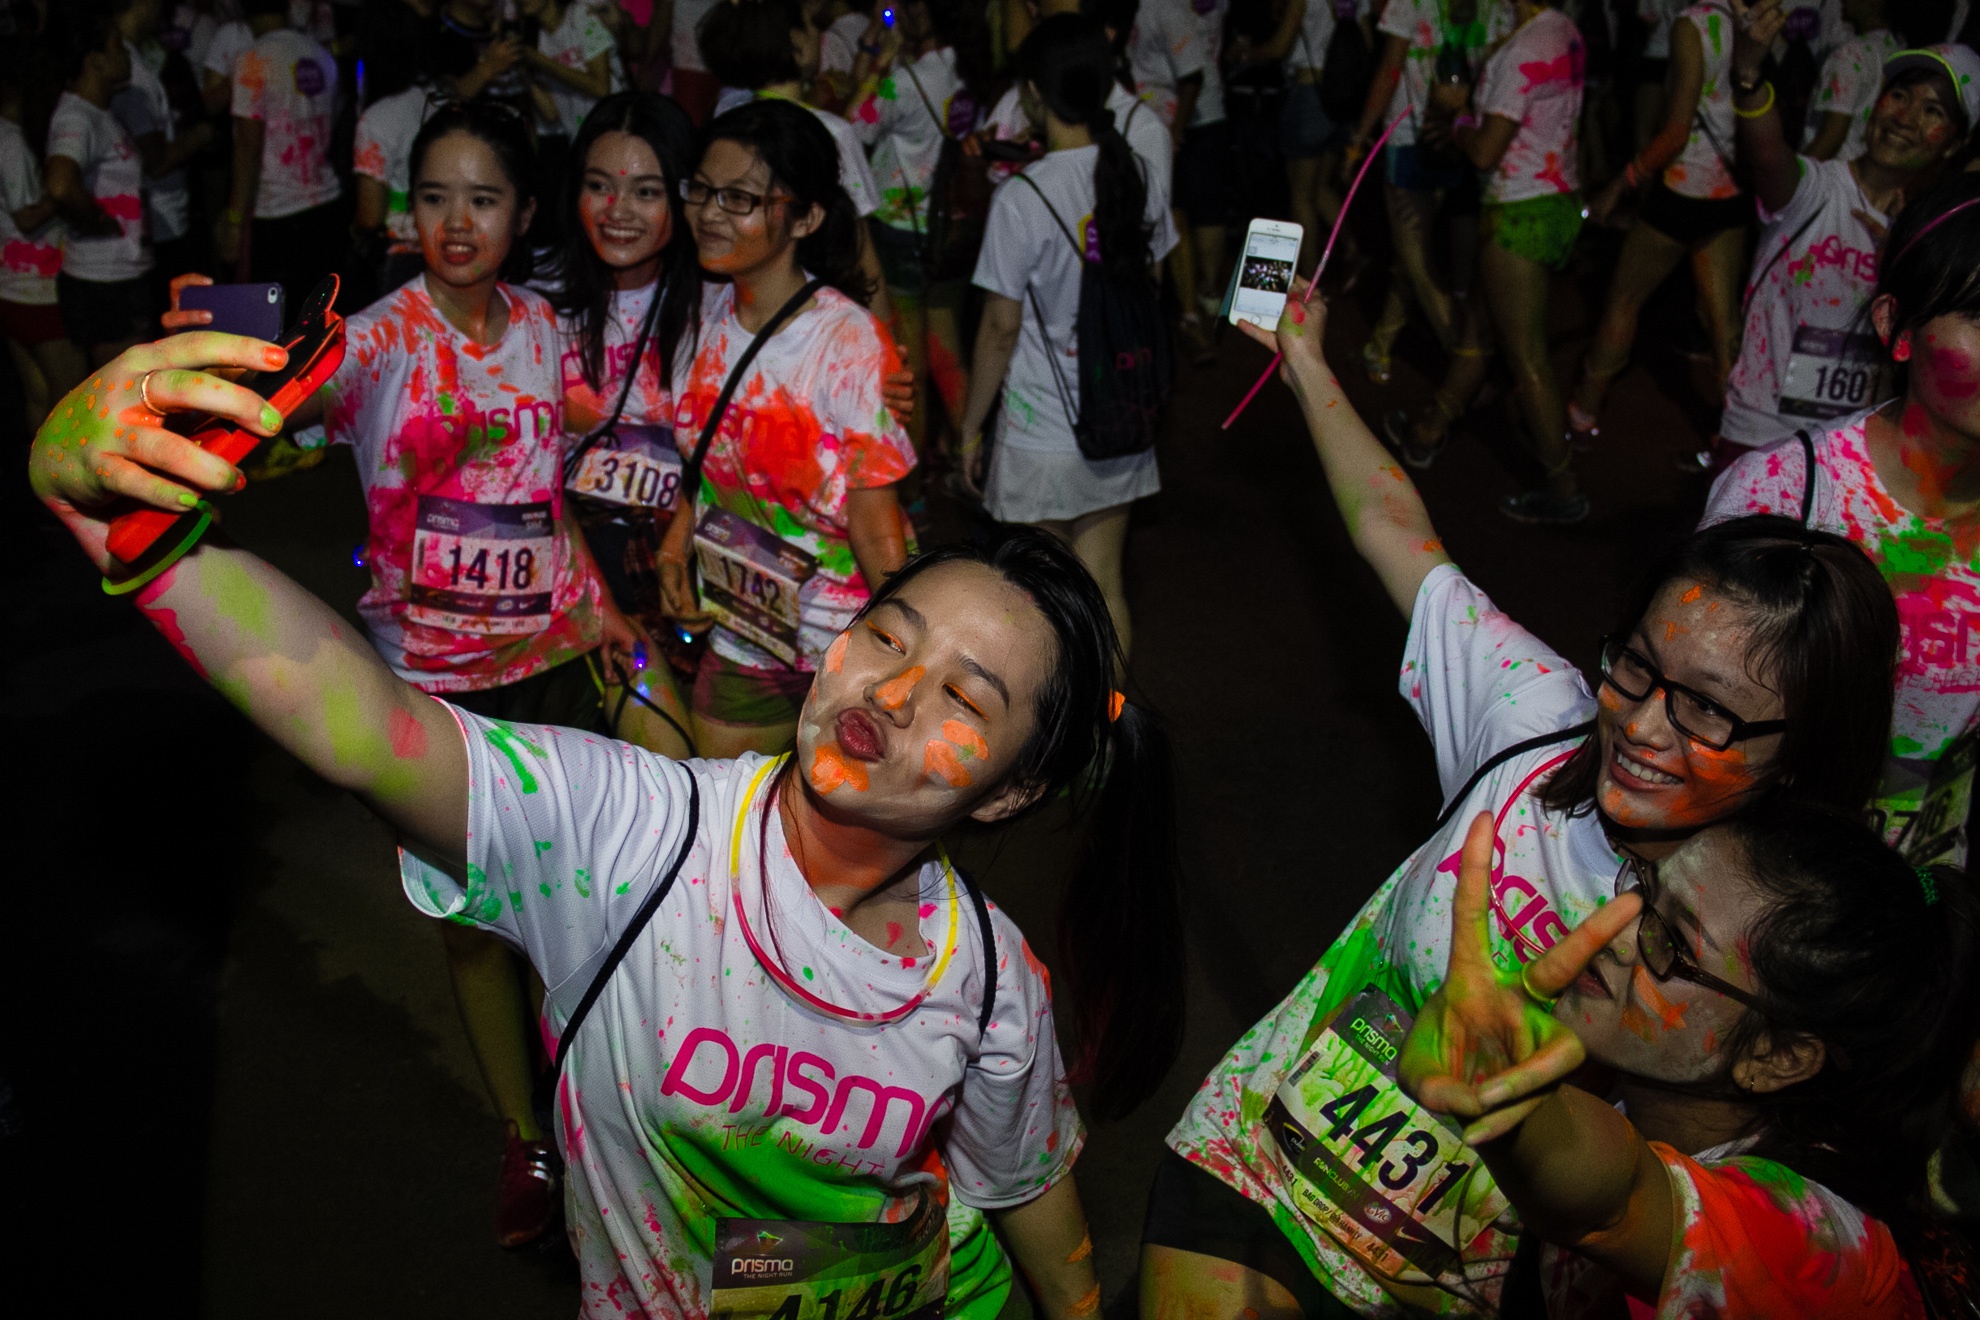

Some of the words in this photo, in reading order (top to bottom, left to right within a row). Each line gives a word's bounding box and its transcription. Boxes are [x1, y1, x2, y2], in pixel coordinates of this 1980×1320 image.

[1815, 365, 1868, 403] 160
[594, 457, 681, 508] 3108
[450, 545, 534, 590] 1418
[720, 557, 783, 615] 1742
[1350, 1018, 1398, 1061] prisma
[722, 1124, 769, 1150] THE
[776, 1131, 886, 1175] NIGHT
[1319, 1084, 1470, 1214] 4431
[1302, 1189, 1316, 1202] BAG
[731, 1258, 794, 1275] prisma
